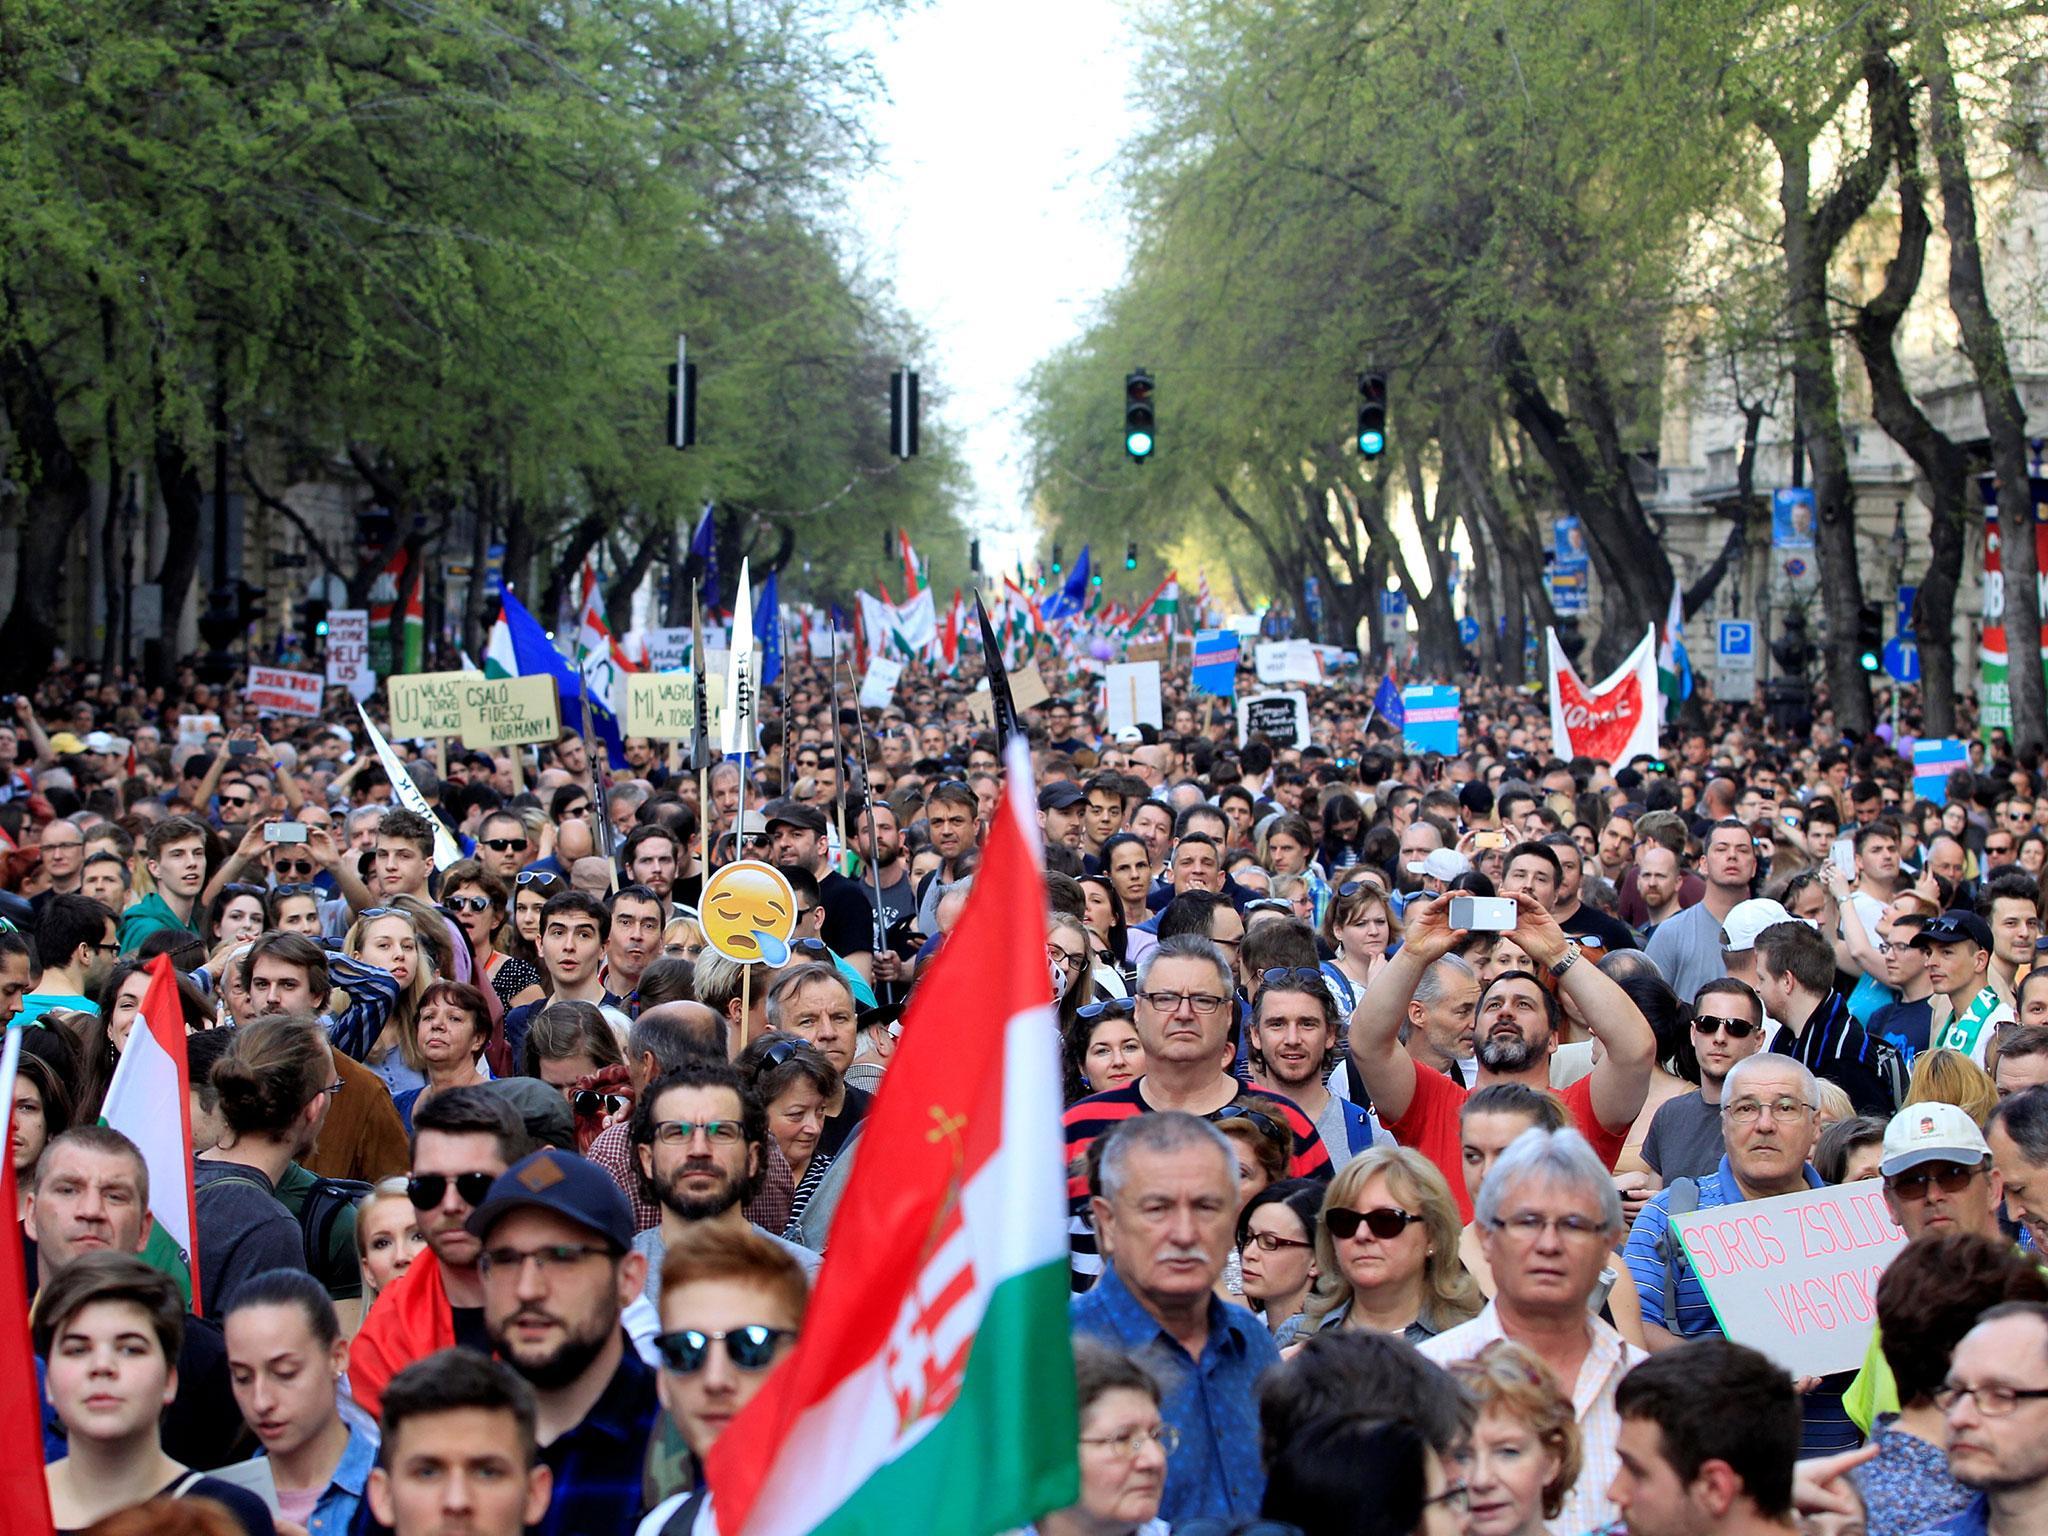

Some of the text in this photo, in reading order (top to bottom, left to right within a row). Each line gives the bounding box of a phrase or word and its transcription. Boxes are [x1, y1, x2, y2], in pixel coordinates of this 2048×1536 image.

[1724, 626, 1746, 652] P
[325, 645, 369, 664] HELP
[337, 666, 358, 681] US
[394, 683, 419, 724] ÚJ
[466, 683, 509, 707] CSALÓ
[634, 688, 655, 719] MI
[479, 703, 526, 723] FIDESZ
[655, 710, 665, 726] A
[1945, 987, 1997, 1050] GYA
[1682, 1192, 1908, 1279] SOROS ZSOLDO
